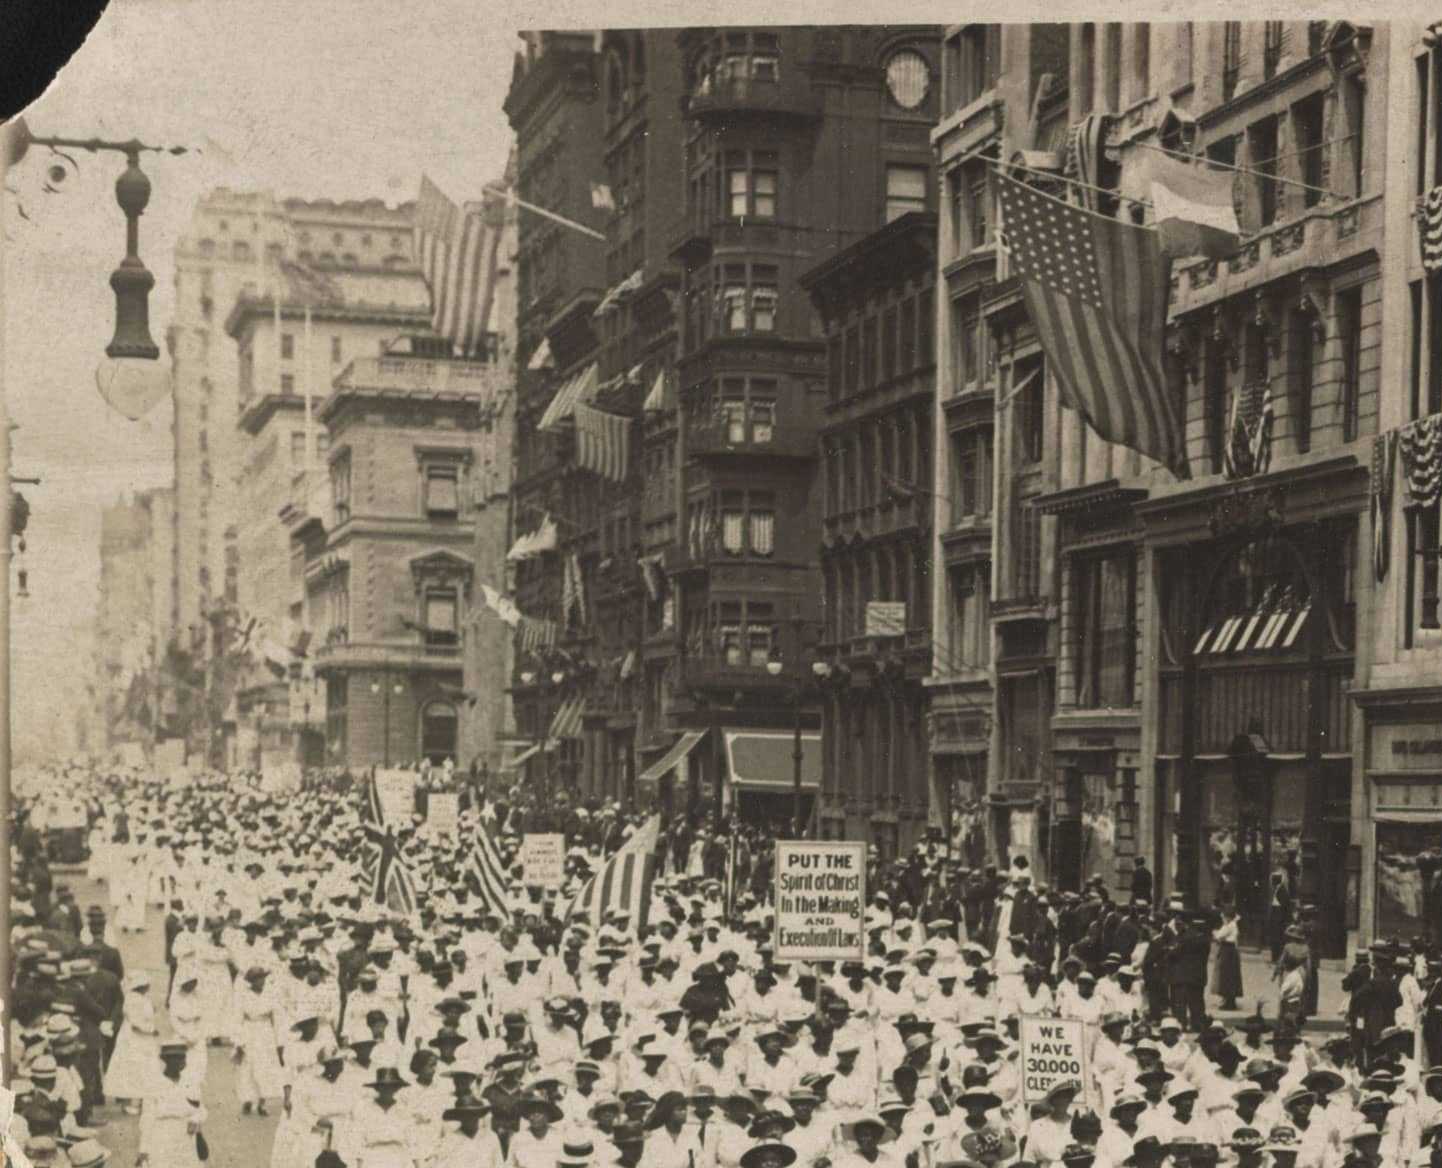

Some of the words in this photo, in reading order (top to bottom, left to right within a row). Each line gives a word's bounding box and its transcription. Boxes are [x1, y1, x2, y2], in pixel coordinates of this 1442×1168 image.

[788, 854, 820, 868] PUT
[825, 854, 853, 869] THE
[780, 872, 813, 893] Spirit
[827, 873, 859, 891] Christ
[781, 895, 792, 913] In
[818, 895, 860, 919] Making
[804, 917, 836, 926] AND
[1040, 1026, 1065, 1039] WE
[1031, 1043, 1072, 1056] HAVE
